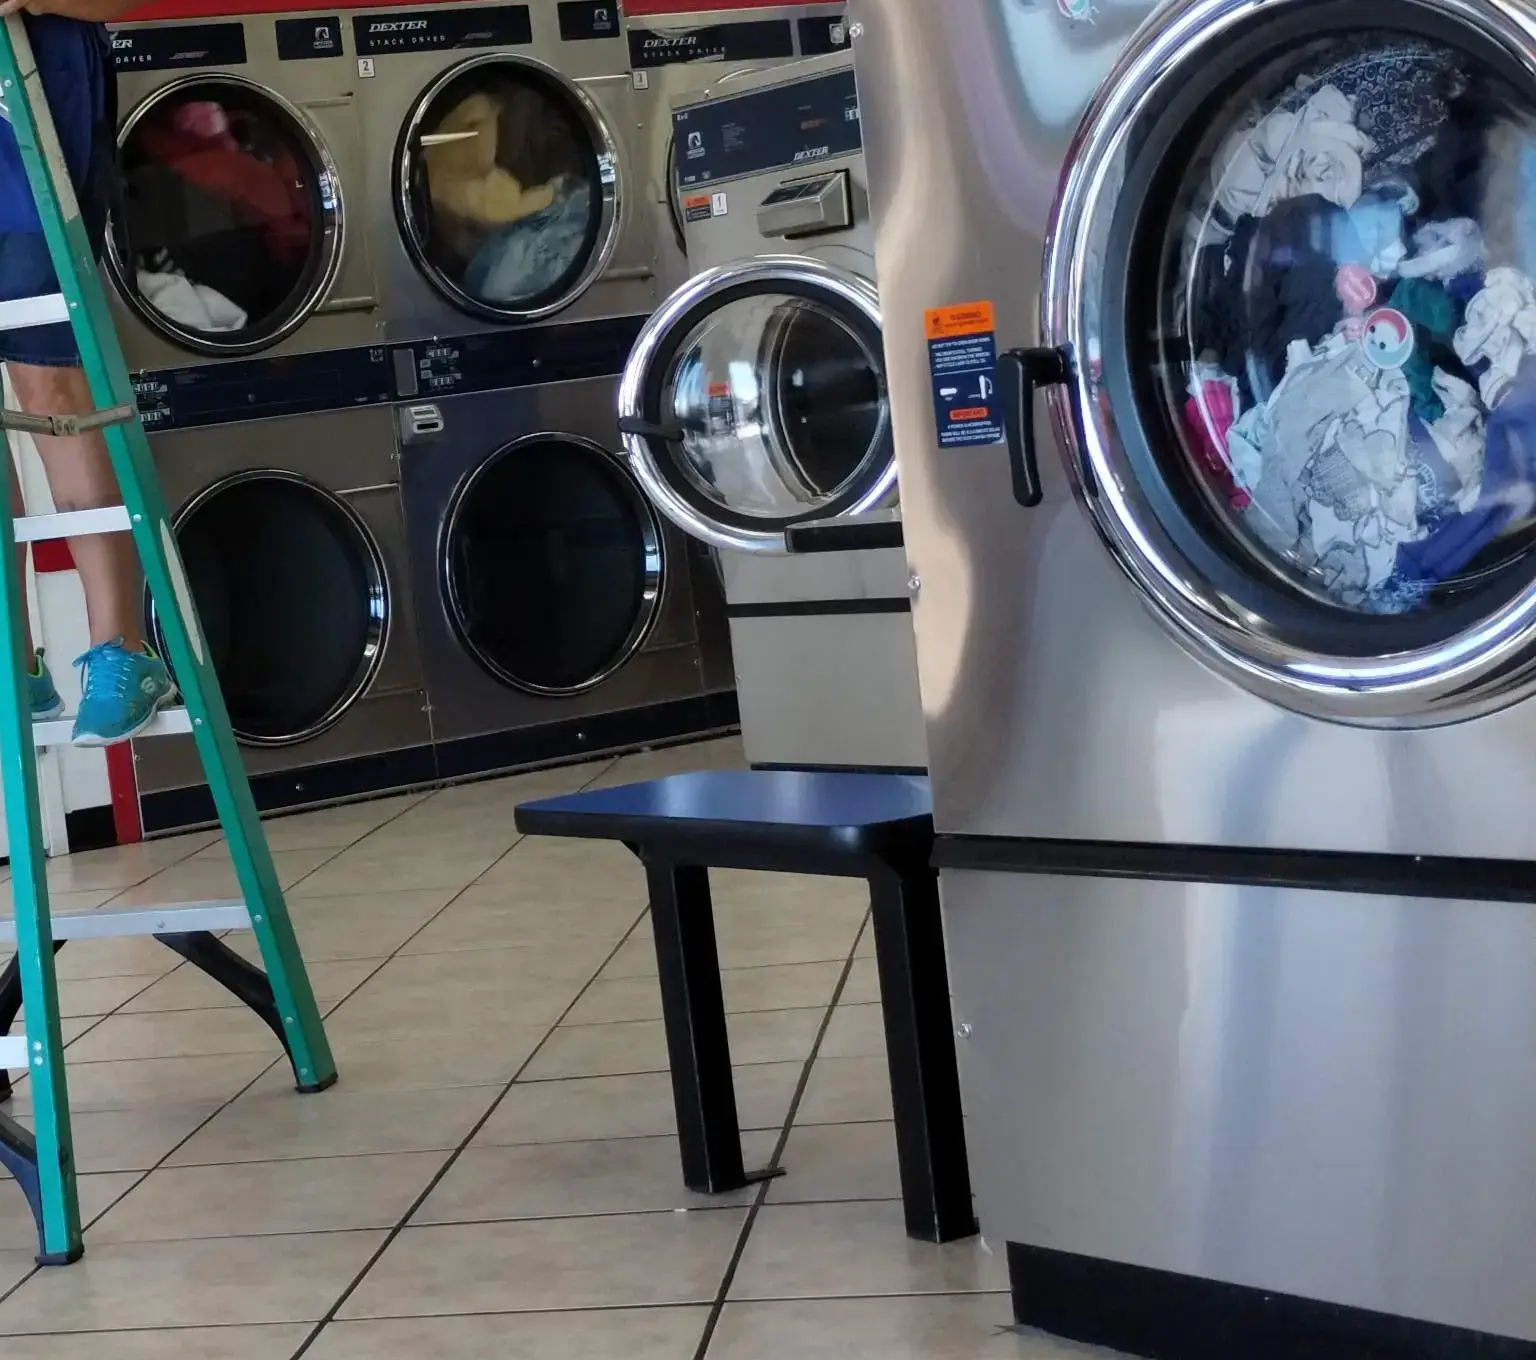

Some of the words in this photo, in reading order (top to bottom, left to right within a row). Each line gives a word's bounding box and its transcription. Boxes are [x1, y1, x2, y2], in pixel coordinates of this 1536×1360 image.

[369, 20, 428, 33] DEXTER
[369, 38, 404, 47] STACK
[643, 36, 697, 48] DEXTER
[116, 53, 152, 64] DRYER
[362, 61, 369, 71] 2
[794, 146, 828, 160] DEXTER
